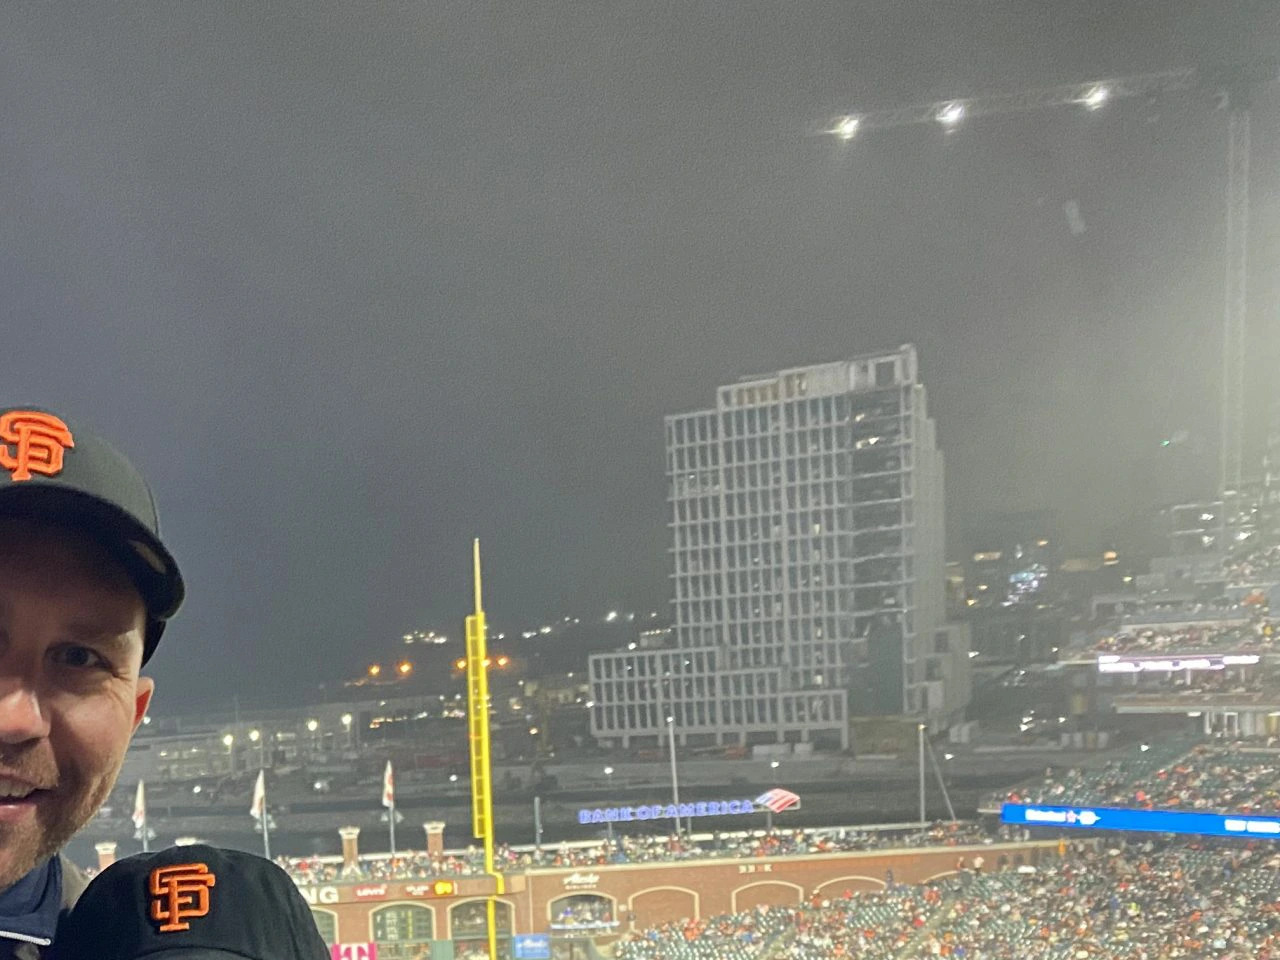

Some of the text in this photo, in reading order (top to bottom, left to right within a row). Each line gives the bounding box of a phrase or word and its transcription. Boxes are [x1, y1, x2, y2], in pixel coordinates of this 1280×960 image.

[578, 800, 754, 824] BANK OF AMERICA
[150, 863, 216, 932] SF
